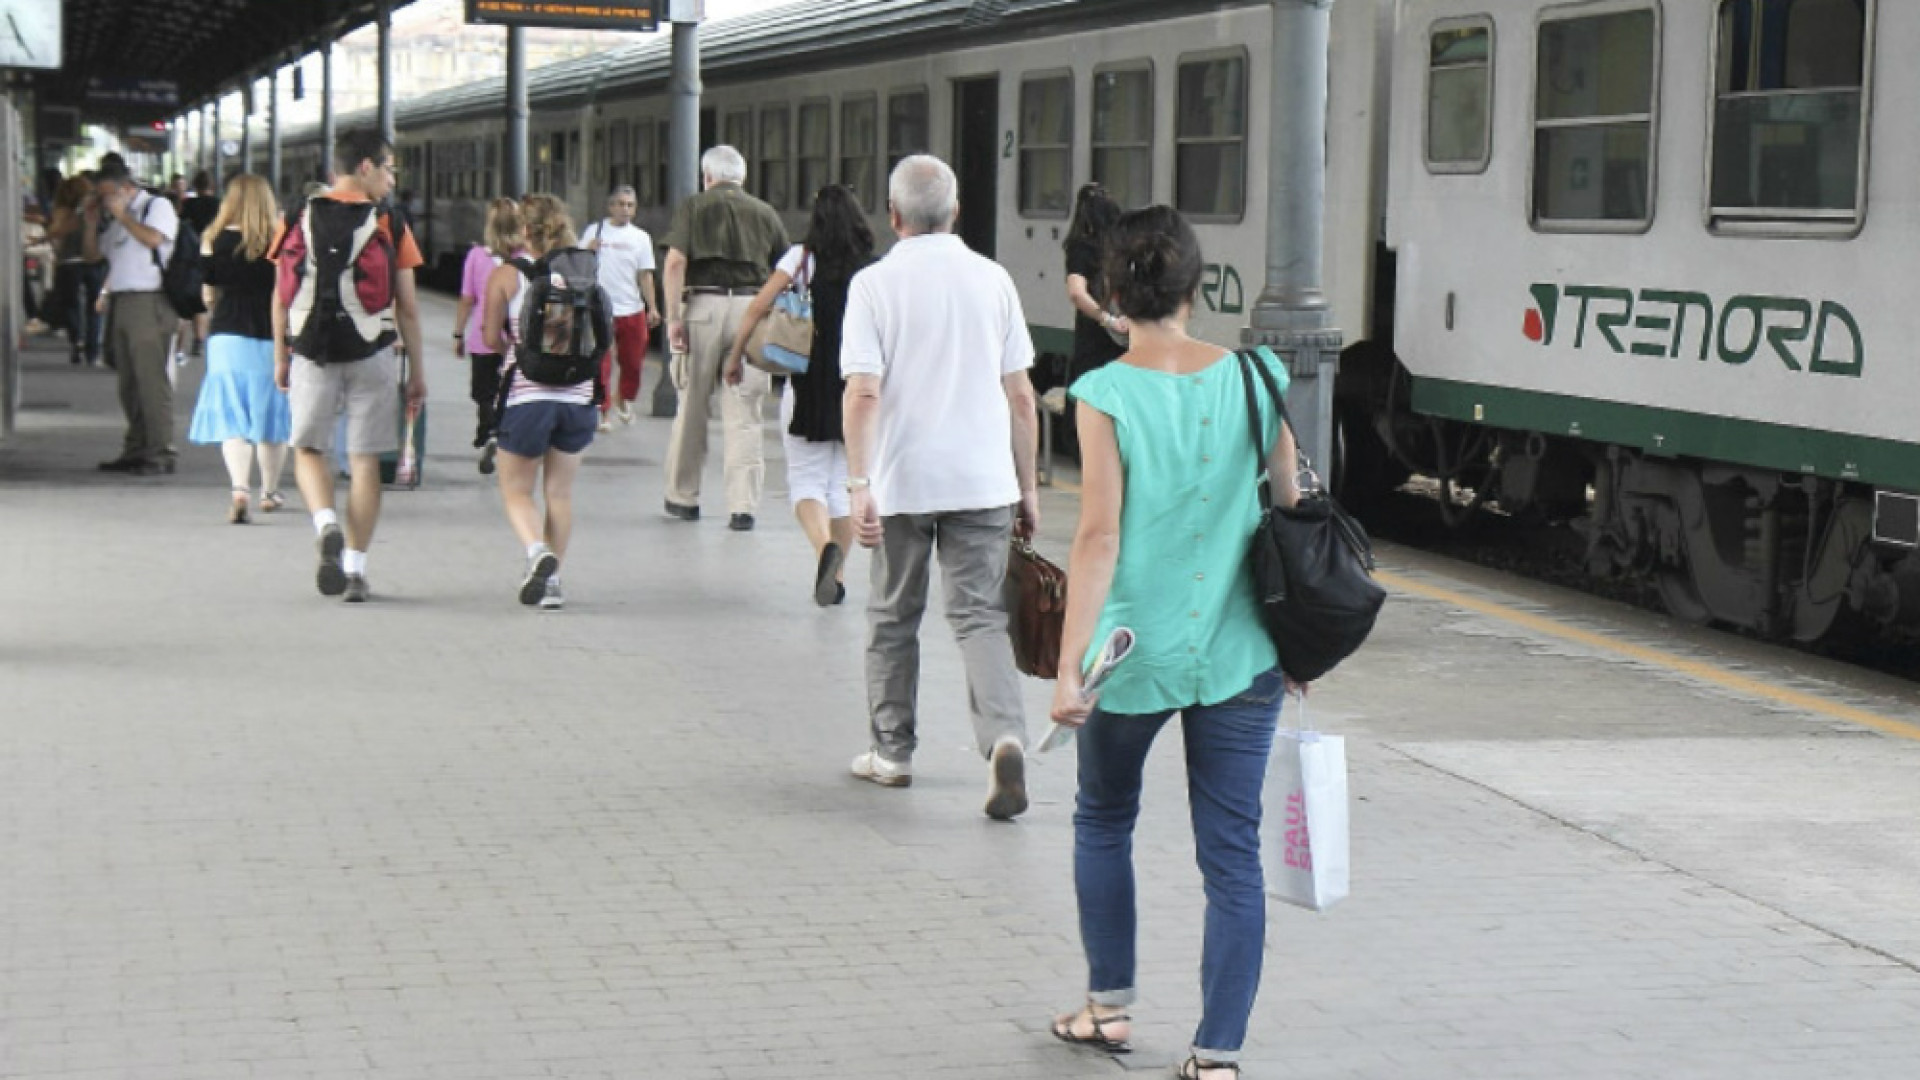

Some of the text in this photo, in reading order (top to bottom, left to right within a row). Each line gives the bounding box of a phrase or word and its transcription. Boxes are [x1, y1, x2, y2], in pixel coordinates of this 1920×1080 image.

[1003, 130, 1015, 158] 2
[1200, 263, 1243, 313] RD
[1564, 284, 1864, 377] TRENORD
[1285, 790, 1302, 867] PAUL
